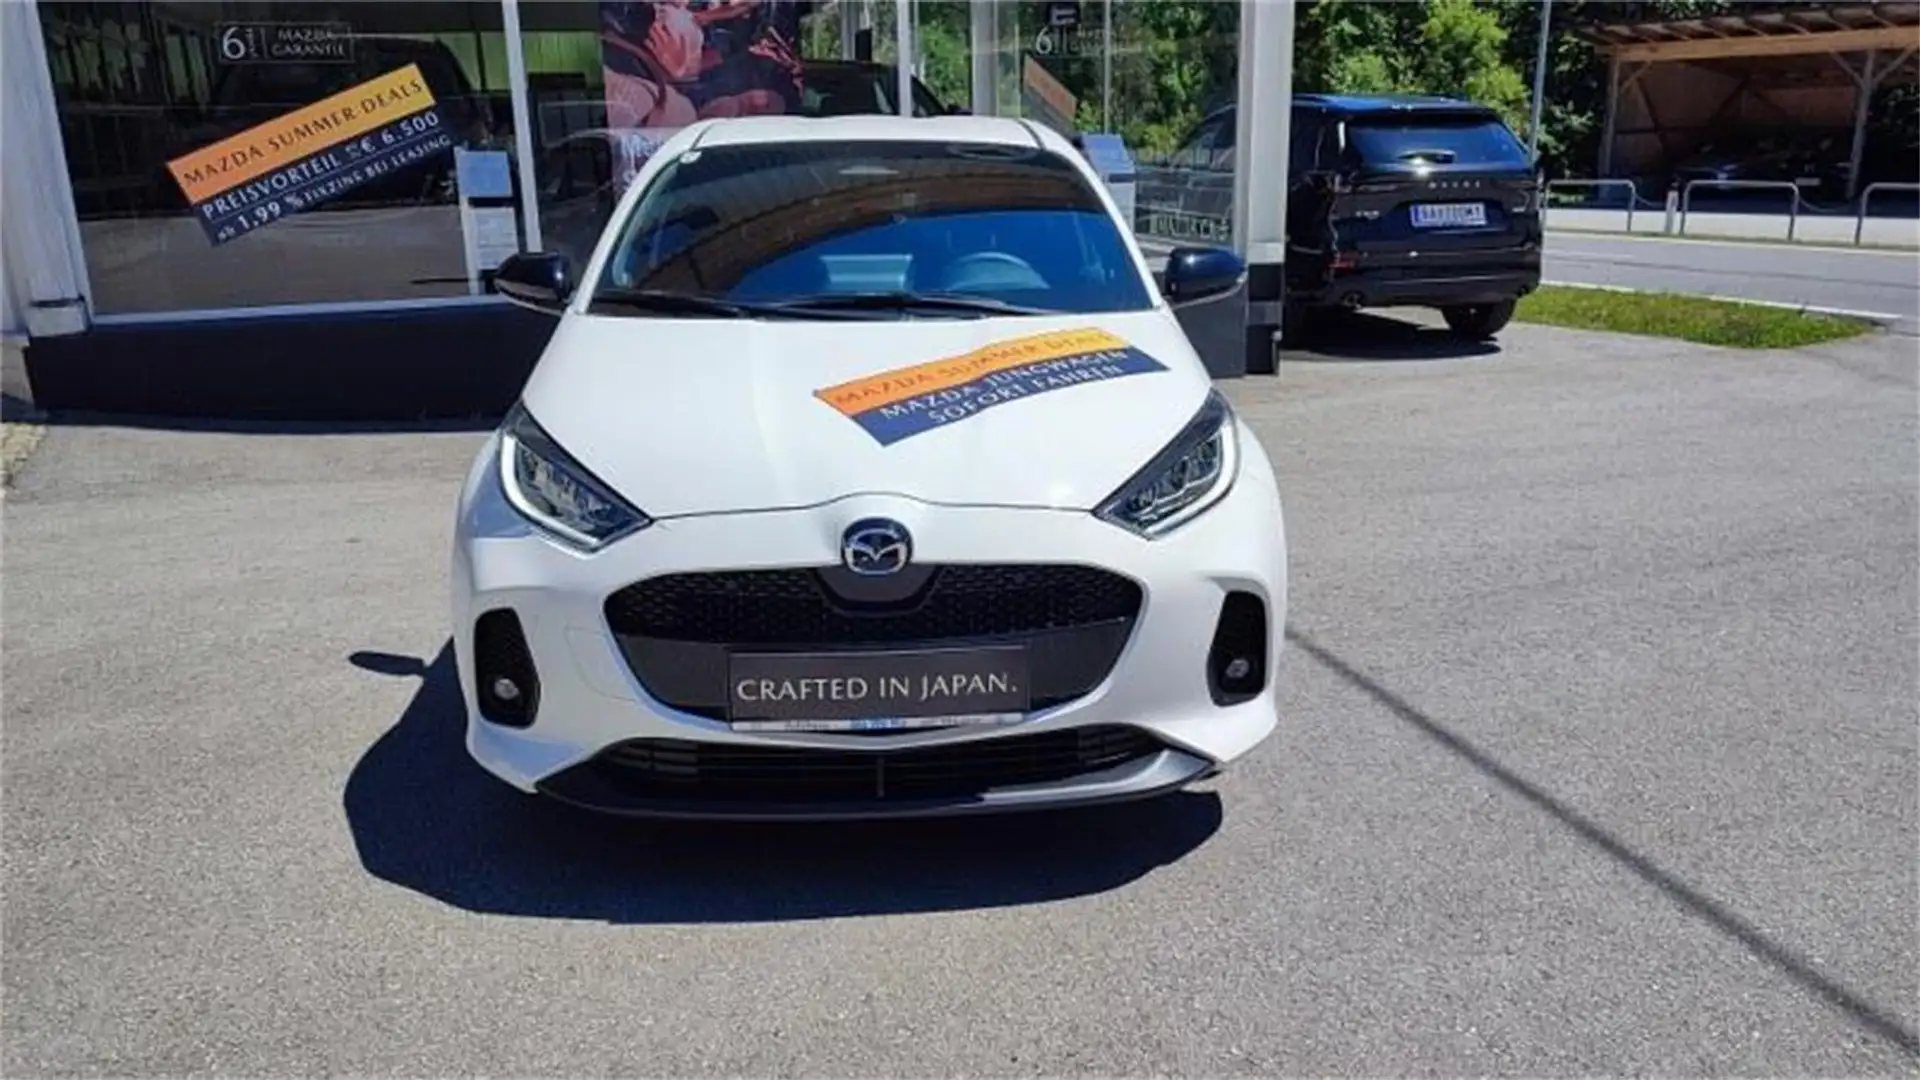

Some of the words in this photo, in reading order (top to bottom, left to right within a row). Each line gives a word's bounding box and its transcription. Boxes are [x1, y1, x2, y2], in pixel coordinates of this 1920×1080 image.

[222, 26, 247, 60] 6
[1035, 26, 1053, 54] 6
[183, 144, 265, 184] MAZDA
[267, 106, 357, 151] SUMMER
[360, 78, 423, 115] DEALS
[202, 153, 342, 220] PREISVORTEIL
[381, 111, 439, 145] 6.500
[237, 201, 281, 229] 1.99
[836, 373, 935, 403] MAZDA
[879, 386, 982, 420] MAZDA
[927, 383, 1028, 425] SOFORT
[1031, 364, 1125, 391] FAHREN
[736, 676, 868, 701] CRAFTED
[879, 675, 909, 699] IN
[919, 672, 1018, 702] JAPAN.
